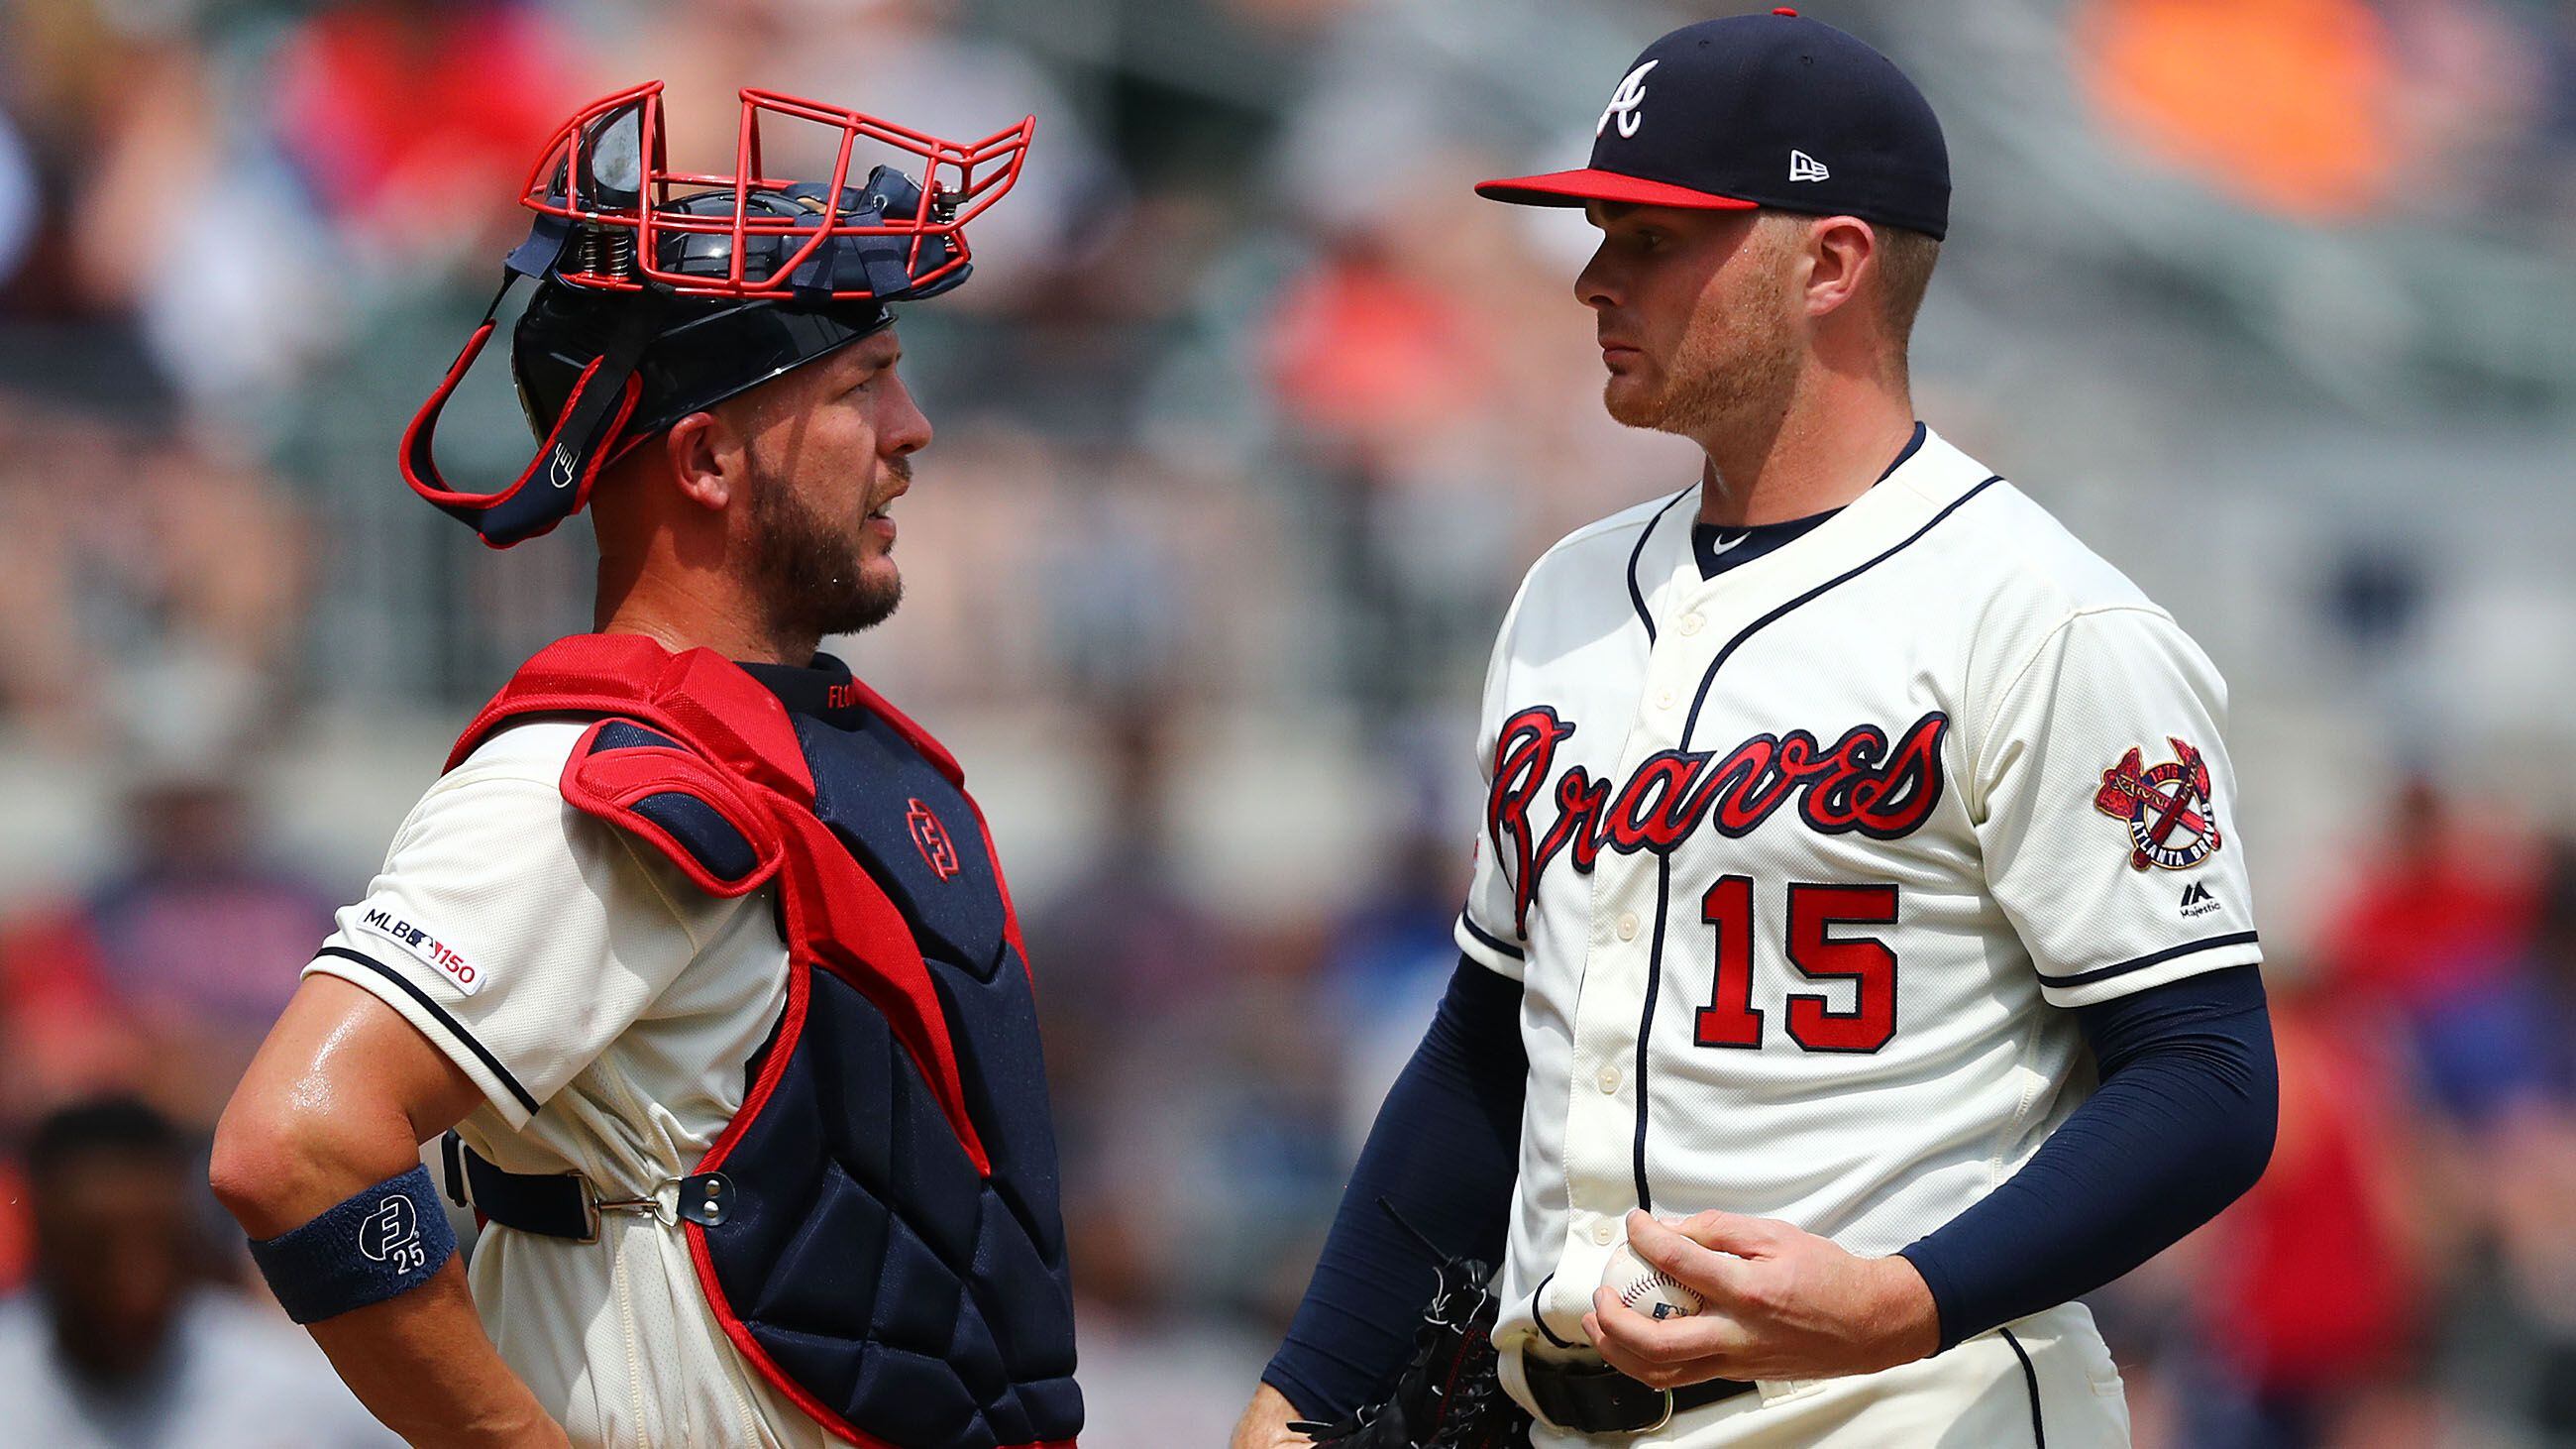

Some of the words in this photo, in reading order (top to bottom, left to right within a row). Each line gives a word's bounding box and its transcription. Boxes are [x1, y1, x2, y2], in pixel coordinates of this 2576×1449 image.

[2149, 764, 2179, 784] 1876
[1488, 705, 1950, 940] Braves
[2131, 821, 2185, 866] ATLANTA
[2180, 901, 2221, 920] Majestic
[364, 908, 411, 939] MLB
[438, 947, 476, 984] 150
[1694, 874, 1899, 1055] 15
[392, 1241, 426, 1276] 25
